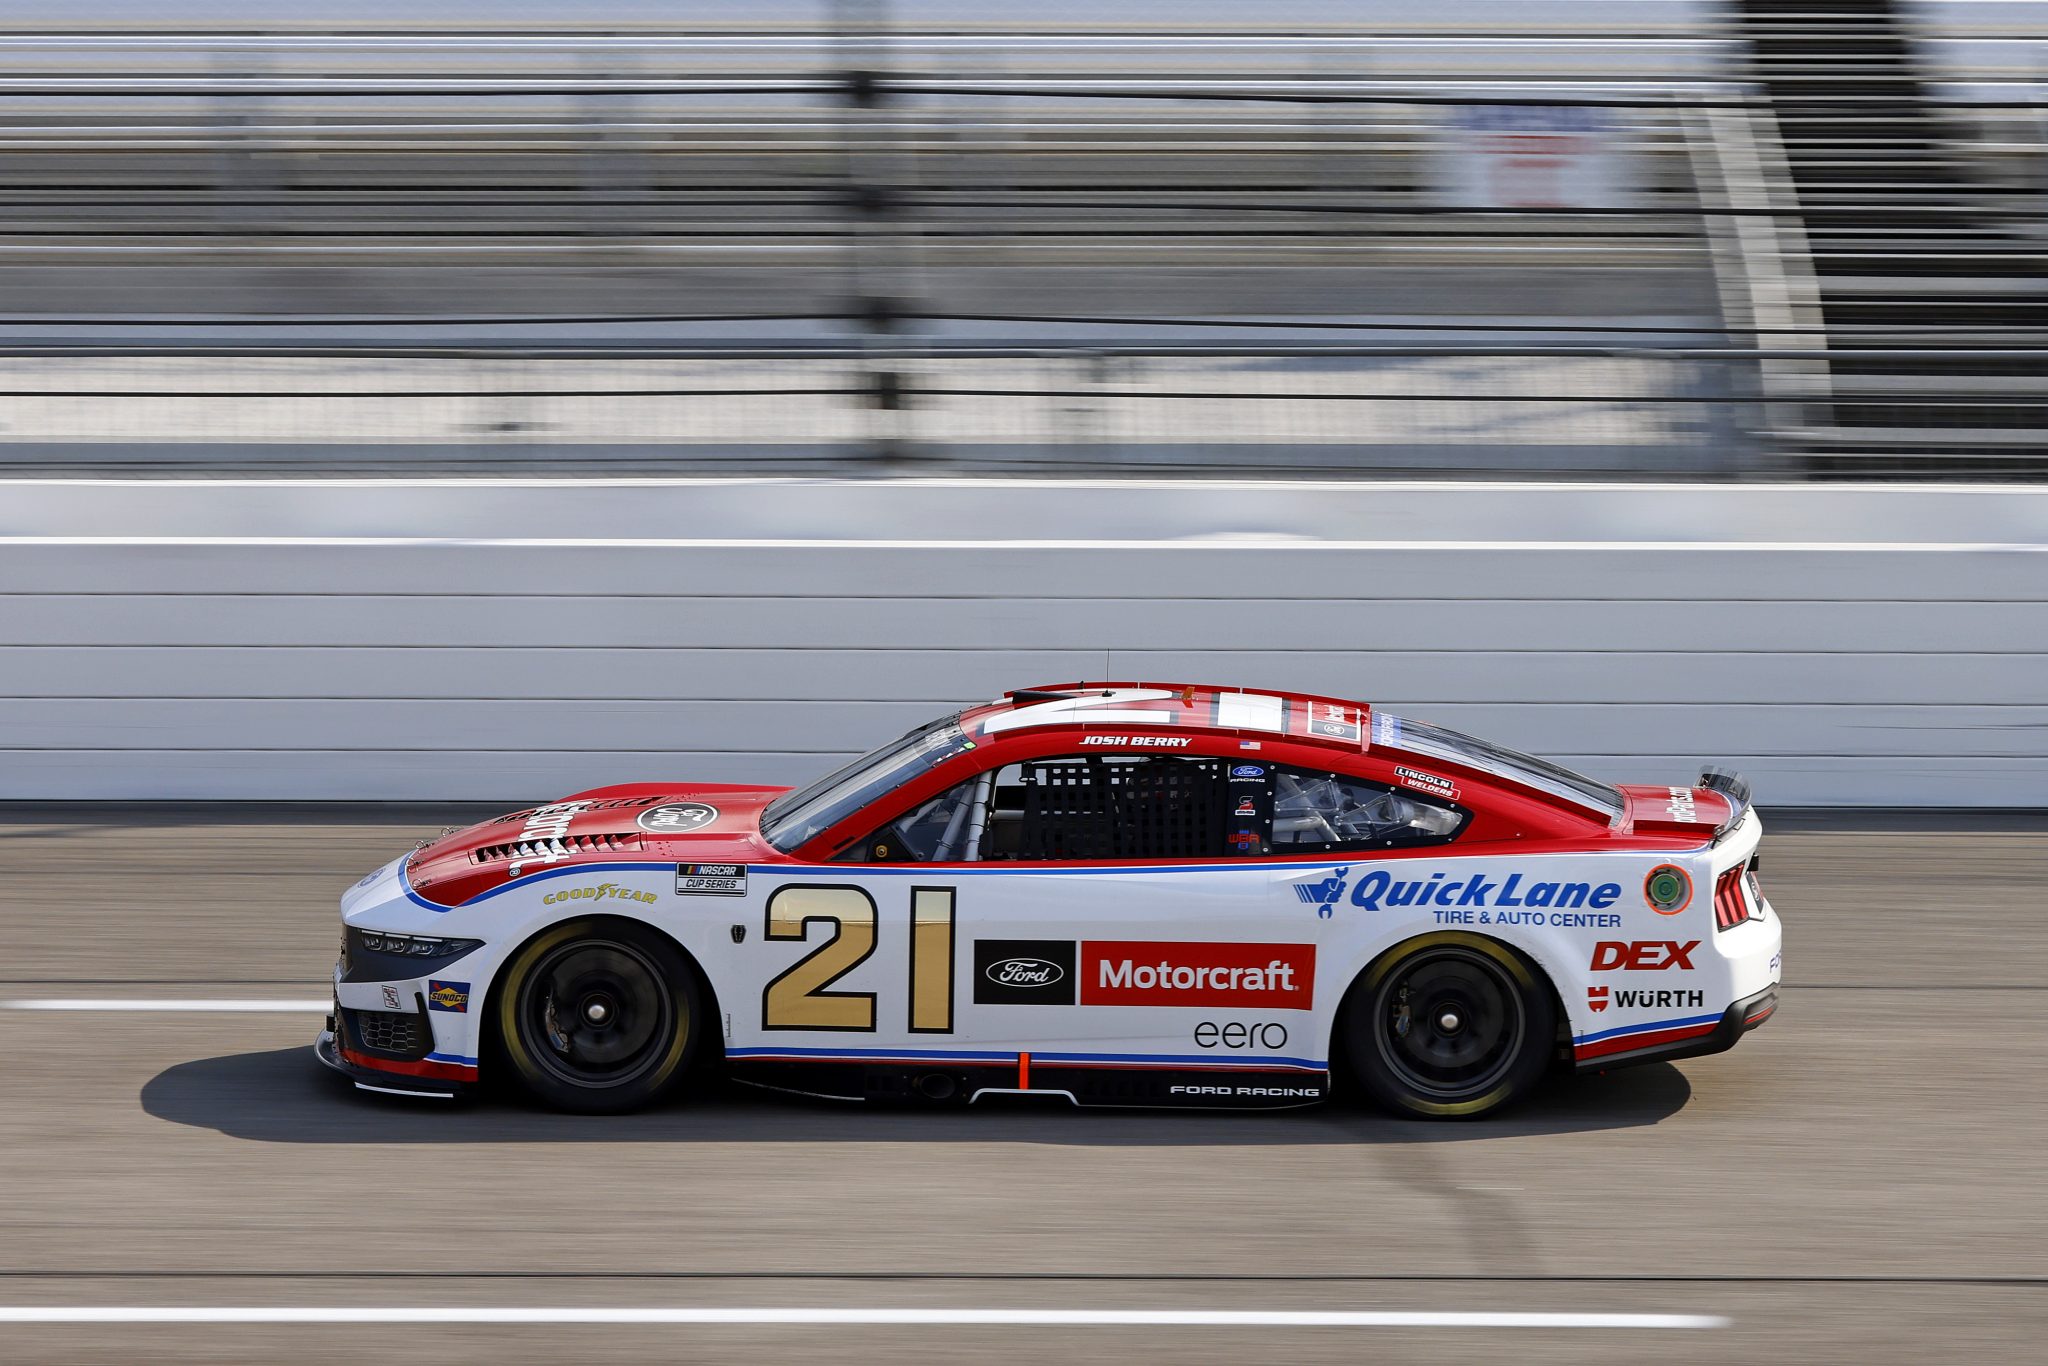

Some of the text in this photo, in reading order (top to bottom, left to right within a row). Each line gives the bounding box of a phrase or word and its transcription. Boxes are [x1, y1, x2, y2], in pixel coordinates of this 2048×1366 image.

[1079, 735, 1192, 748] JOSH BERRY
[1237, 767, 1258, 775] Ford
[1398, 769, 1452, 788] LINCOLN
[1407, 779, 1454, 797] WELDERS
[1665, 786, 1698, 822] ordParts.com
[650, 806, 709, 827] Ford
[699, 866, 737, 876] NASCAR
[686, 879, 737, 889] CUP SERIES
[1434, 910, 1621, 928] TIRE & AUTO CENTER
[762, 882, 957, 1034] 21
[1590, 940, 1702, 971] DEX
[999, 961, 1050, 983] Ford
[431, 991, 468, 1004] SUNOCO
[1194, 1021, 1288, 1050] eero
[1170, 1085, 1320, 1097] FORD RACING
